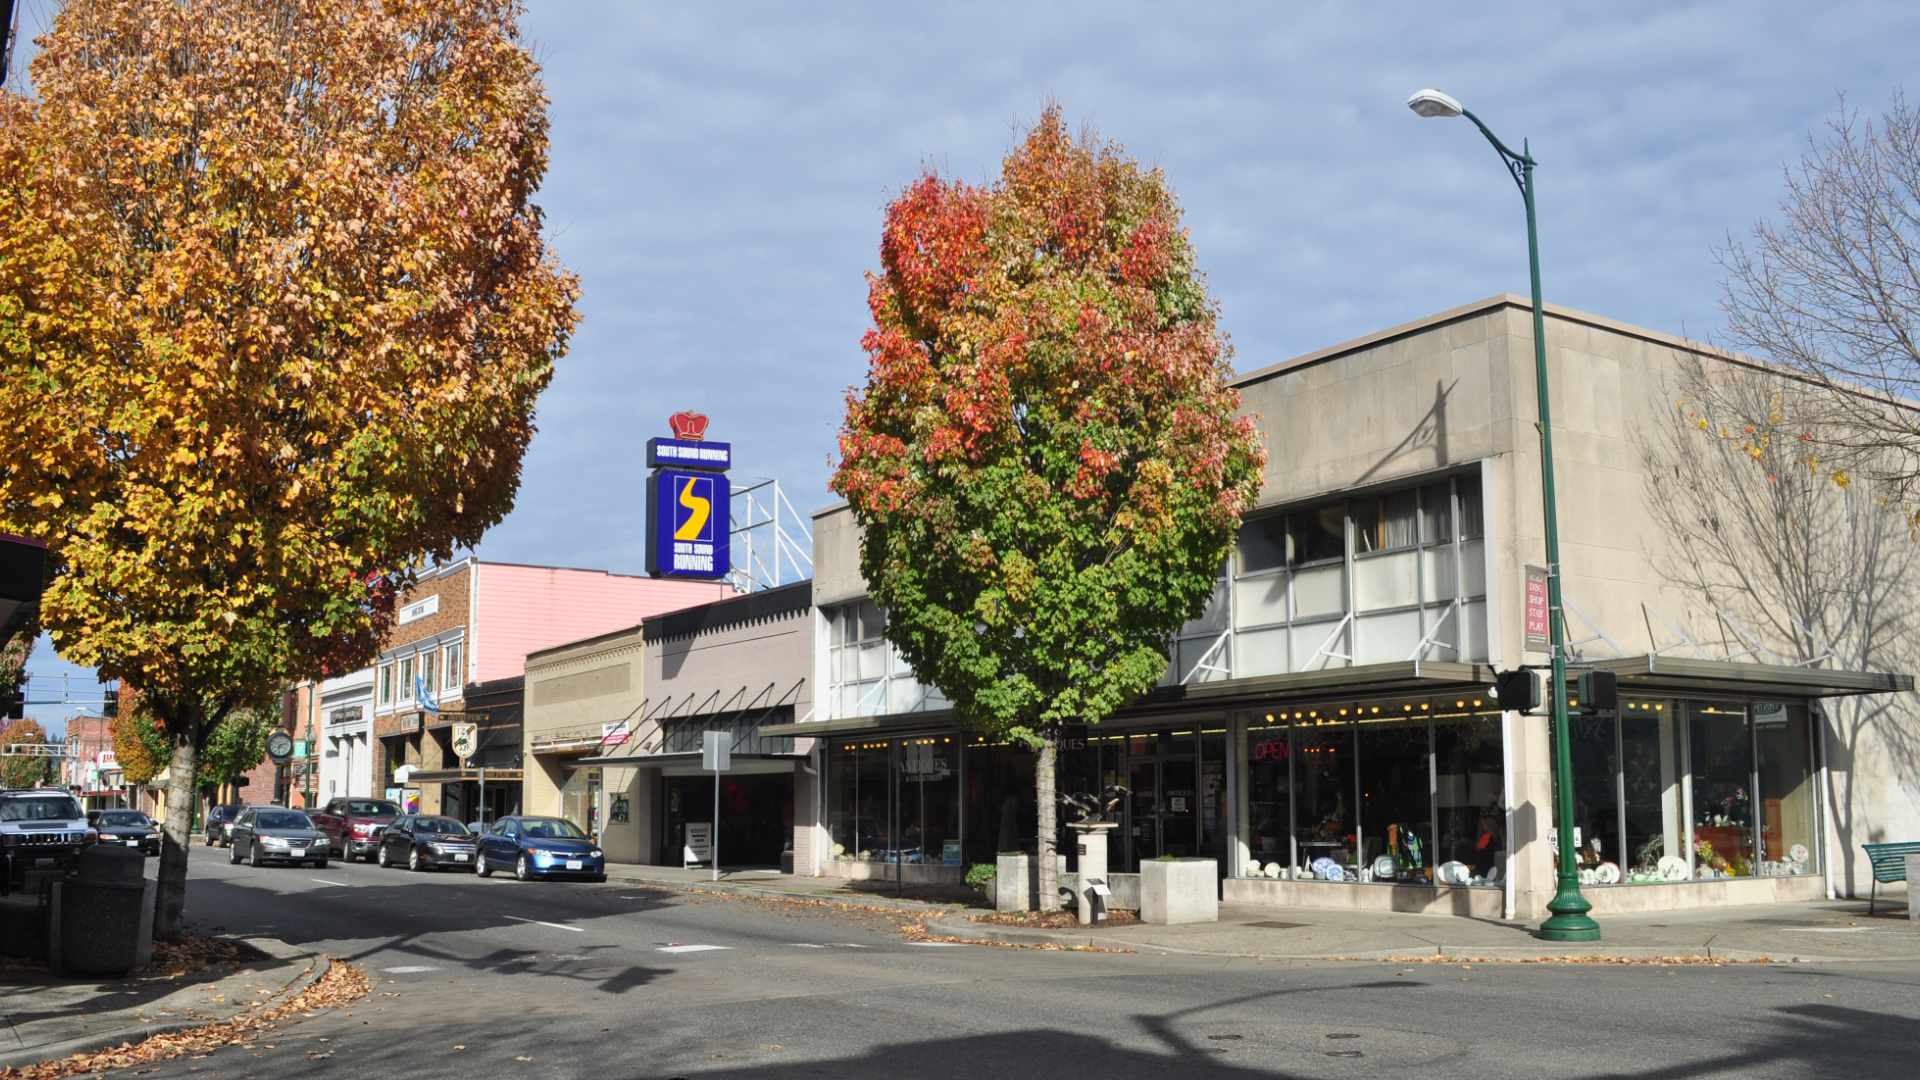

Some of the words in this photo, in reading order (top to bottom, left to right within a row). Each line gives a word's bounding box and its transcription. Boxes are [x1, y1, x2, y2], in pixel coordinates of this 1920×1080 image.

[656, 445, 677, 458] SOUTH
[678, 446, 698, 459] SOUND
[699, 448, 728, 461] RUNNING
[674, 542, 693, 554] SOUTH
[694, 544, 713, 555] SOUND
[674, 554, 713, 572] RUNNING
[1528, 621, 1544, 632] PLAY
[1255, 742, 1290, 760] OPEN
